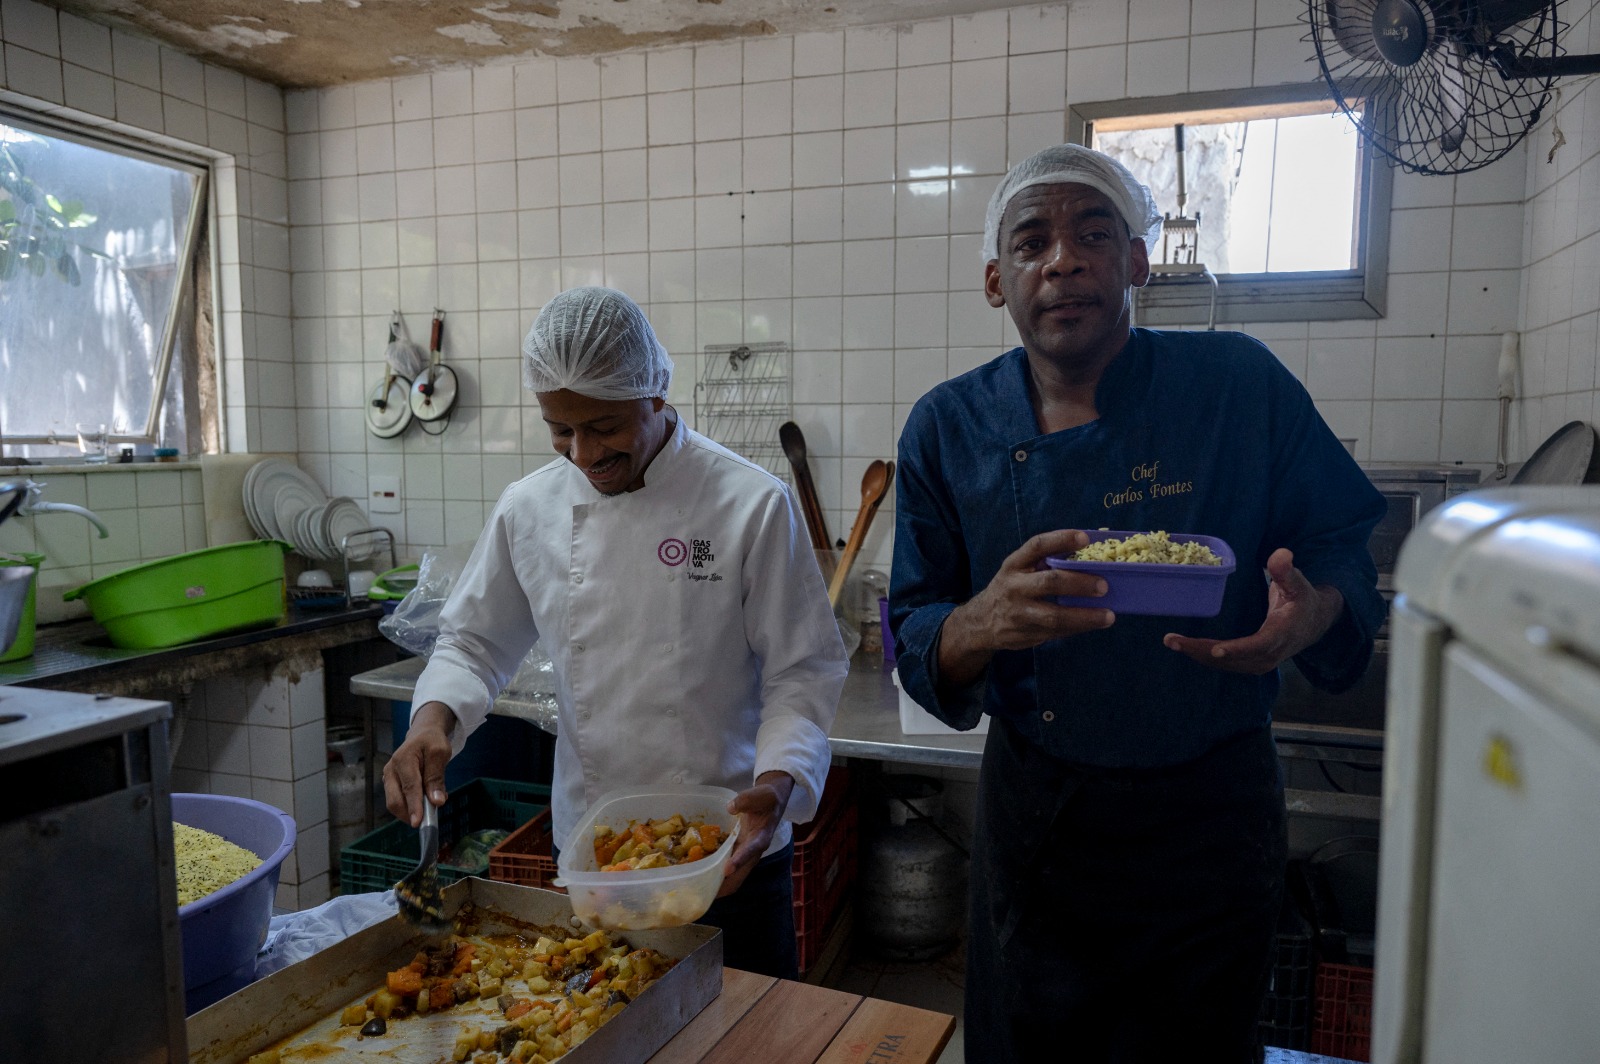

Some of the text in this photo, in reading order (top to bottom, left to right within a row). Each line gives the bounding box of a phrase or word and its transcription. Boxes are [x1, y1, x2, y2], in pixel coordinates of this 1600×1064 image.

[1131, 461, 1160, 482] Chef
[1103, 480, 1193, 509] Carlos Fontes
[692, 539, 711, 548] GAS
[692, 546, 710, 554] TRO
[692, 553, 715, 562] MOTI
[692, 560, 704, 568] VA
